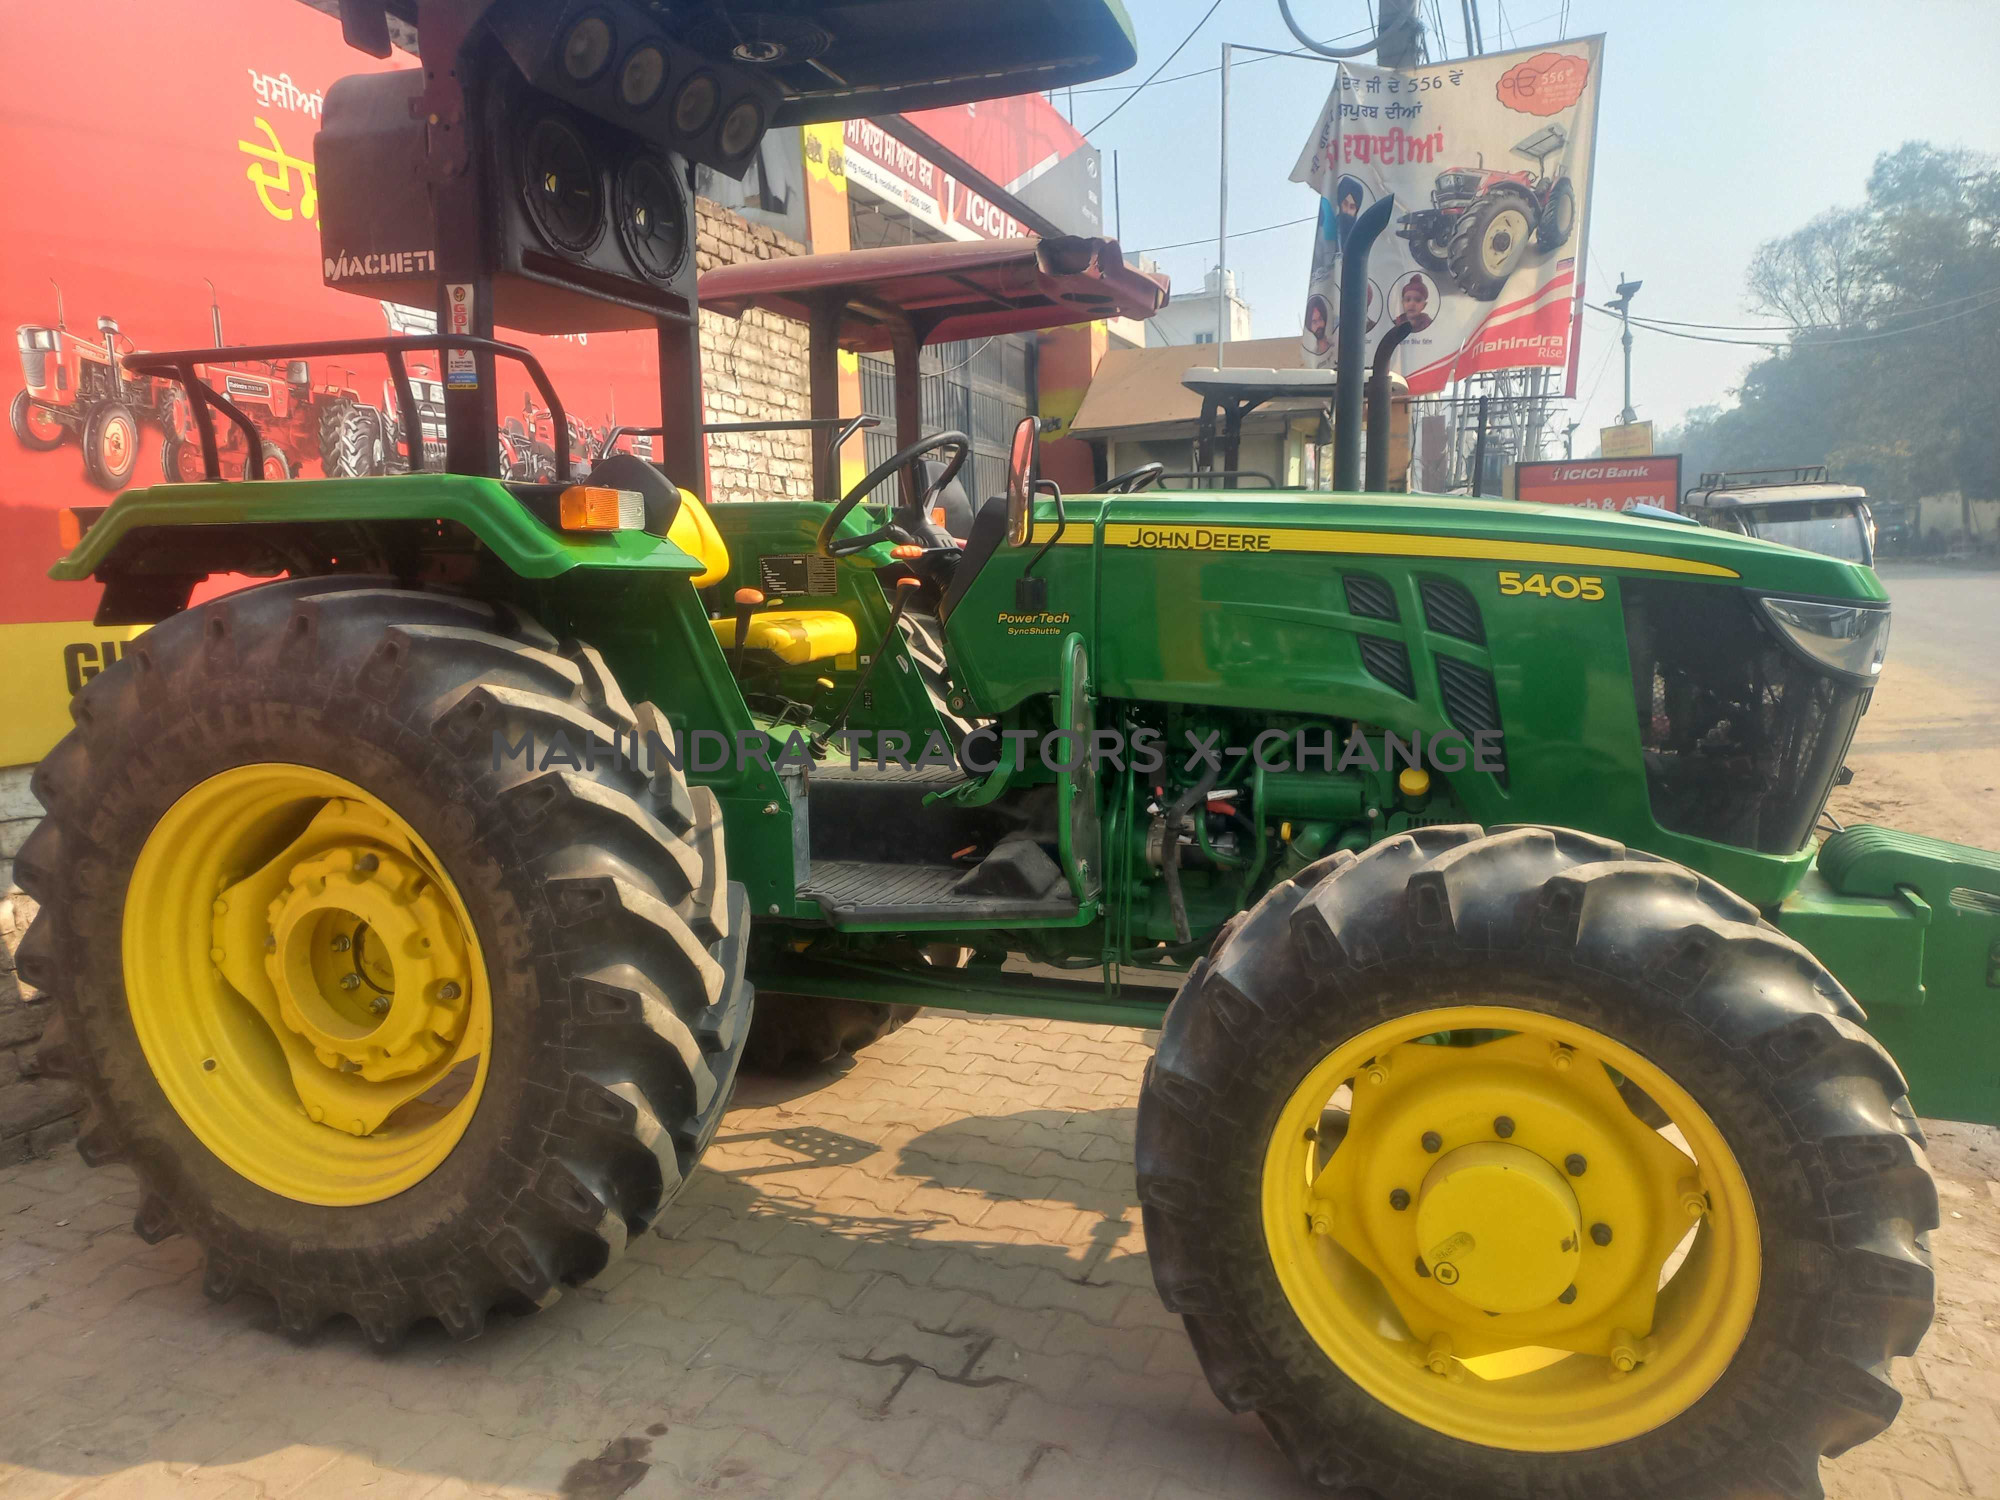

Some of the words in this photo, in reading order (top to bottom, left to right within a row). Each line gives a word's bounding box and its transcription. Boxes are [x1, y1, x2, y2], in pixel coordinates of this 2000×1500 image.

[1407, 76, 1443, 93] 556
[965, 190, 1006, 240] ICICI
[1563, 467, 1603, 481] ICICI
[1606, 466, 1649, 479] Bank
[1498, 571, 1605, 600] 5405
